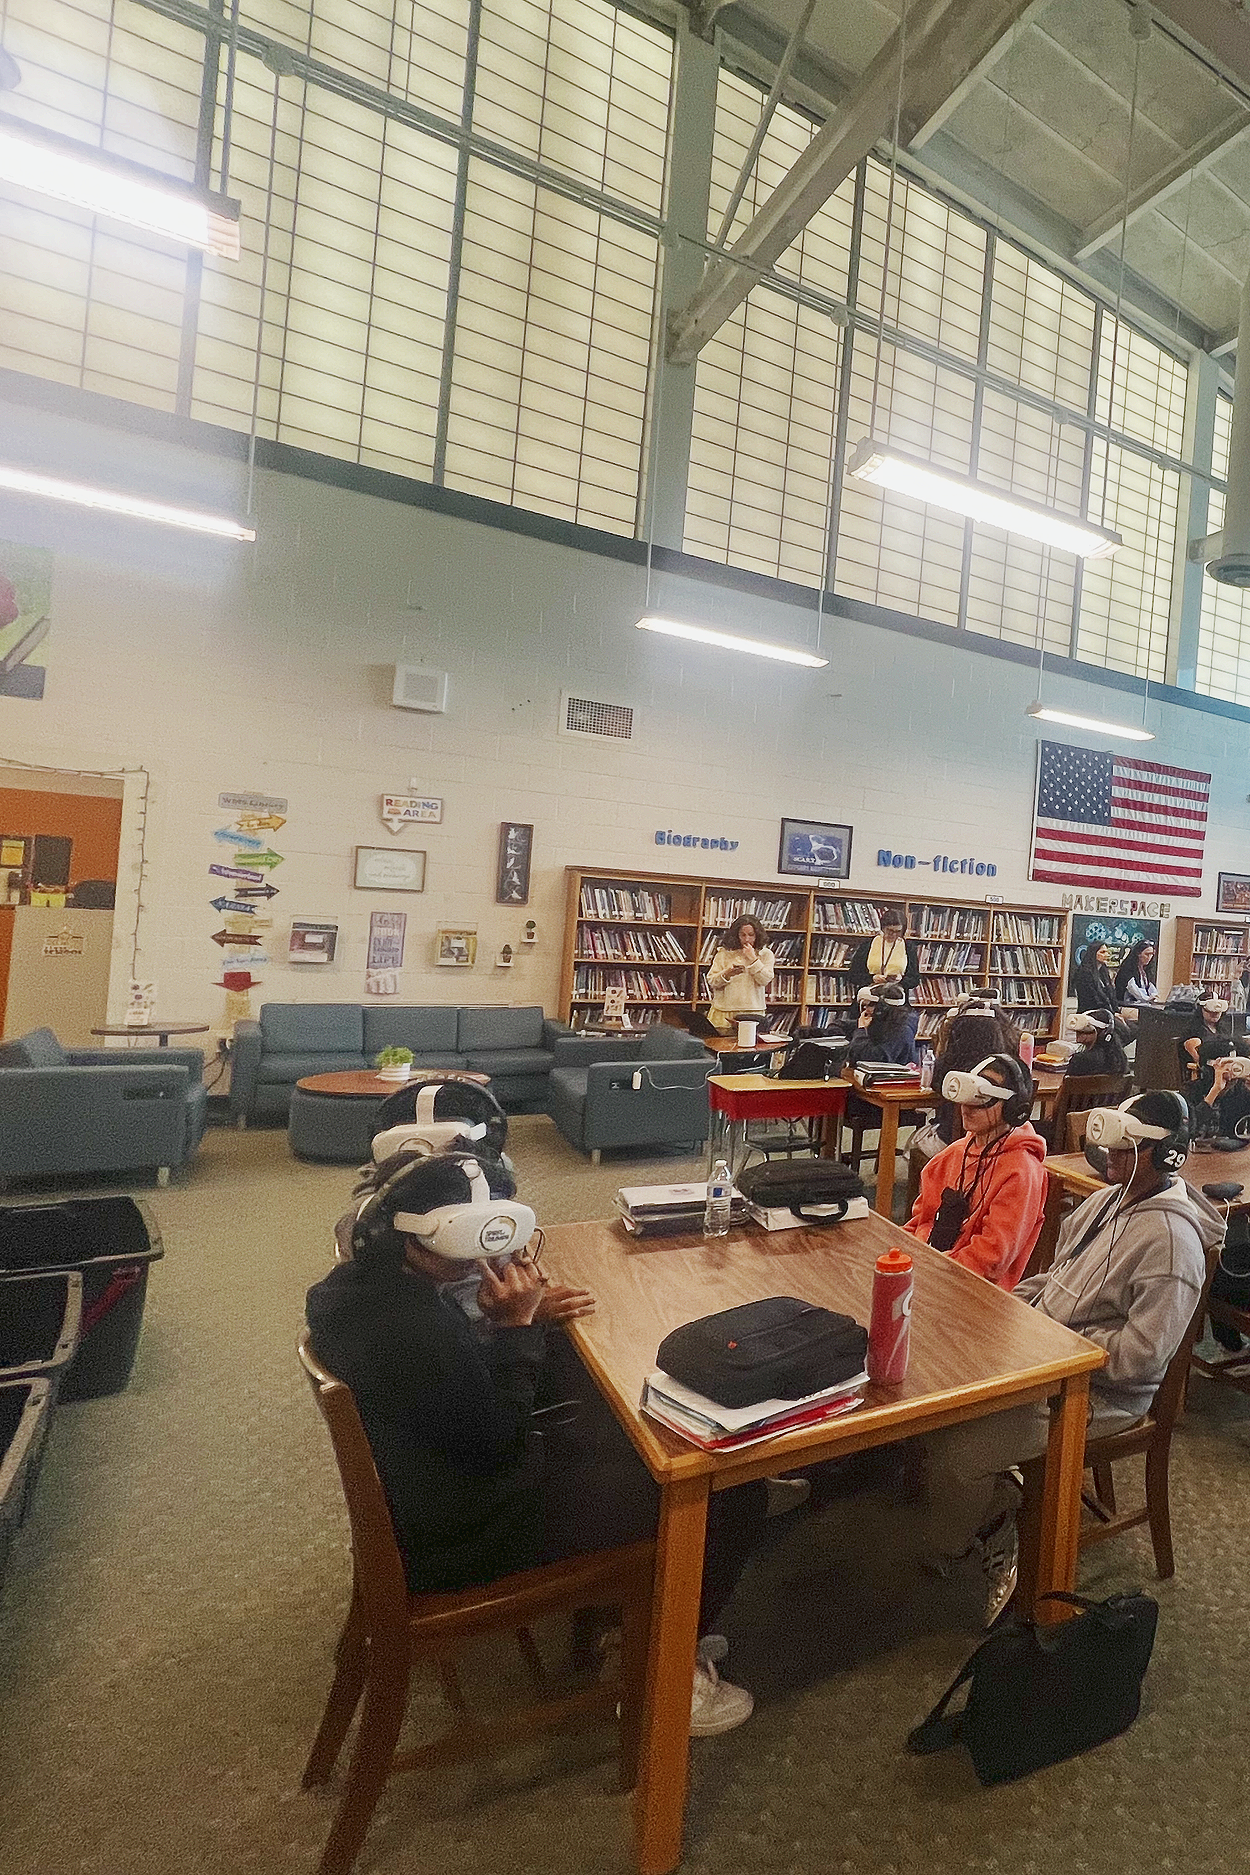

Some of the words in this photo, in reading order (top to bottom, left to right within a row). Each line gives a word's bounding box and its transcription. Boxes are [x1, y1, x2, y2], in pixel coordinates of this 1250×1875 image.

[385, 798, 439, 810] READING
[403, 809, 437, 818] AREA
[655, 830, 740, 851] Biography
[877, 849, 997, 877] Non-fiction
[1061, 892, 1171, 919] MAKERSPACE
[1163, 1149, 1186, 1168] 29
